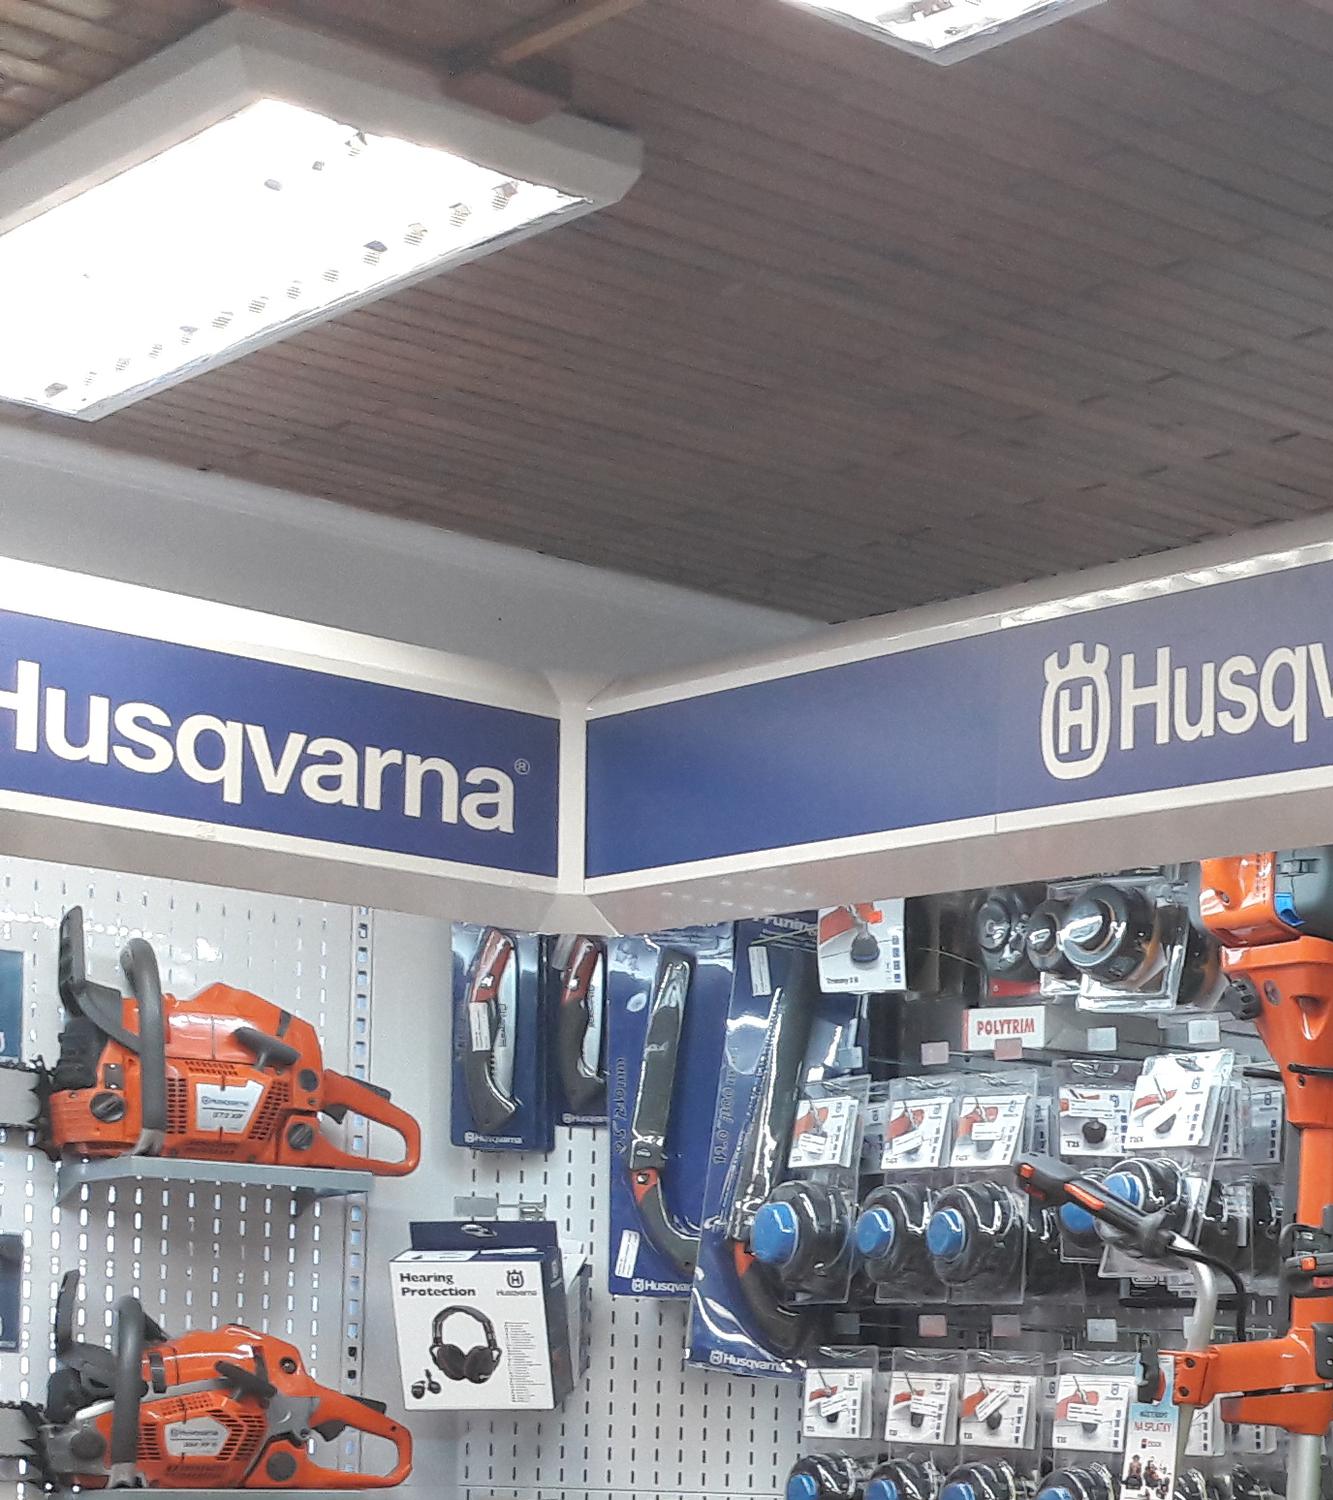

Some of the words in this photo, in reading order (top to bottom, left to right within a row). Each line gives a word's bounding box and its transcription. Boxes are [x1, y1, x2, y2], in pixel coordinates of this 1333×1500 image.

[976, 1017, 1036, 1035] POLYTRIM
[399, 1272, 454, 1287] Hearing
[401, 1285, 476, 1298] Protection
